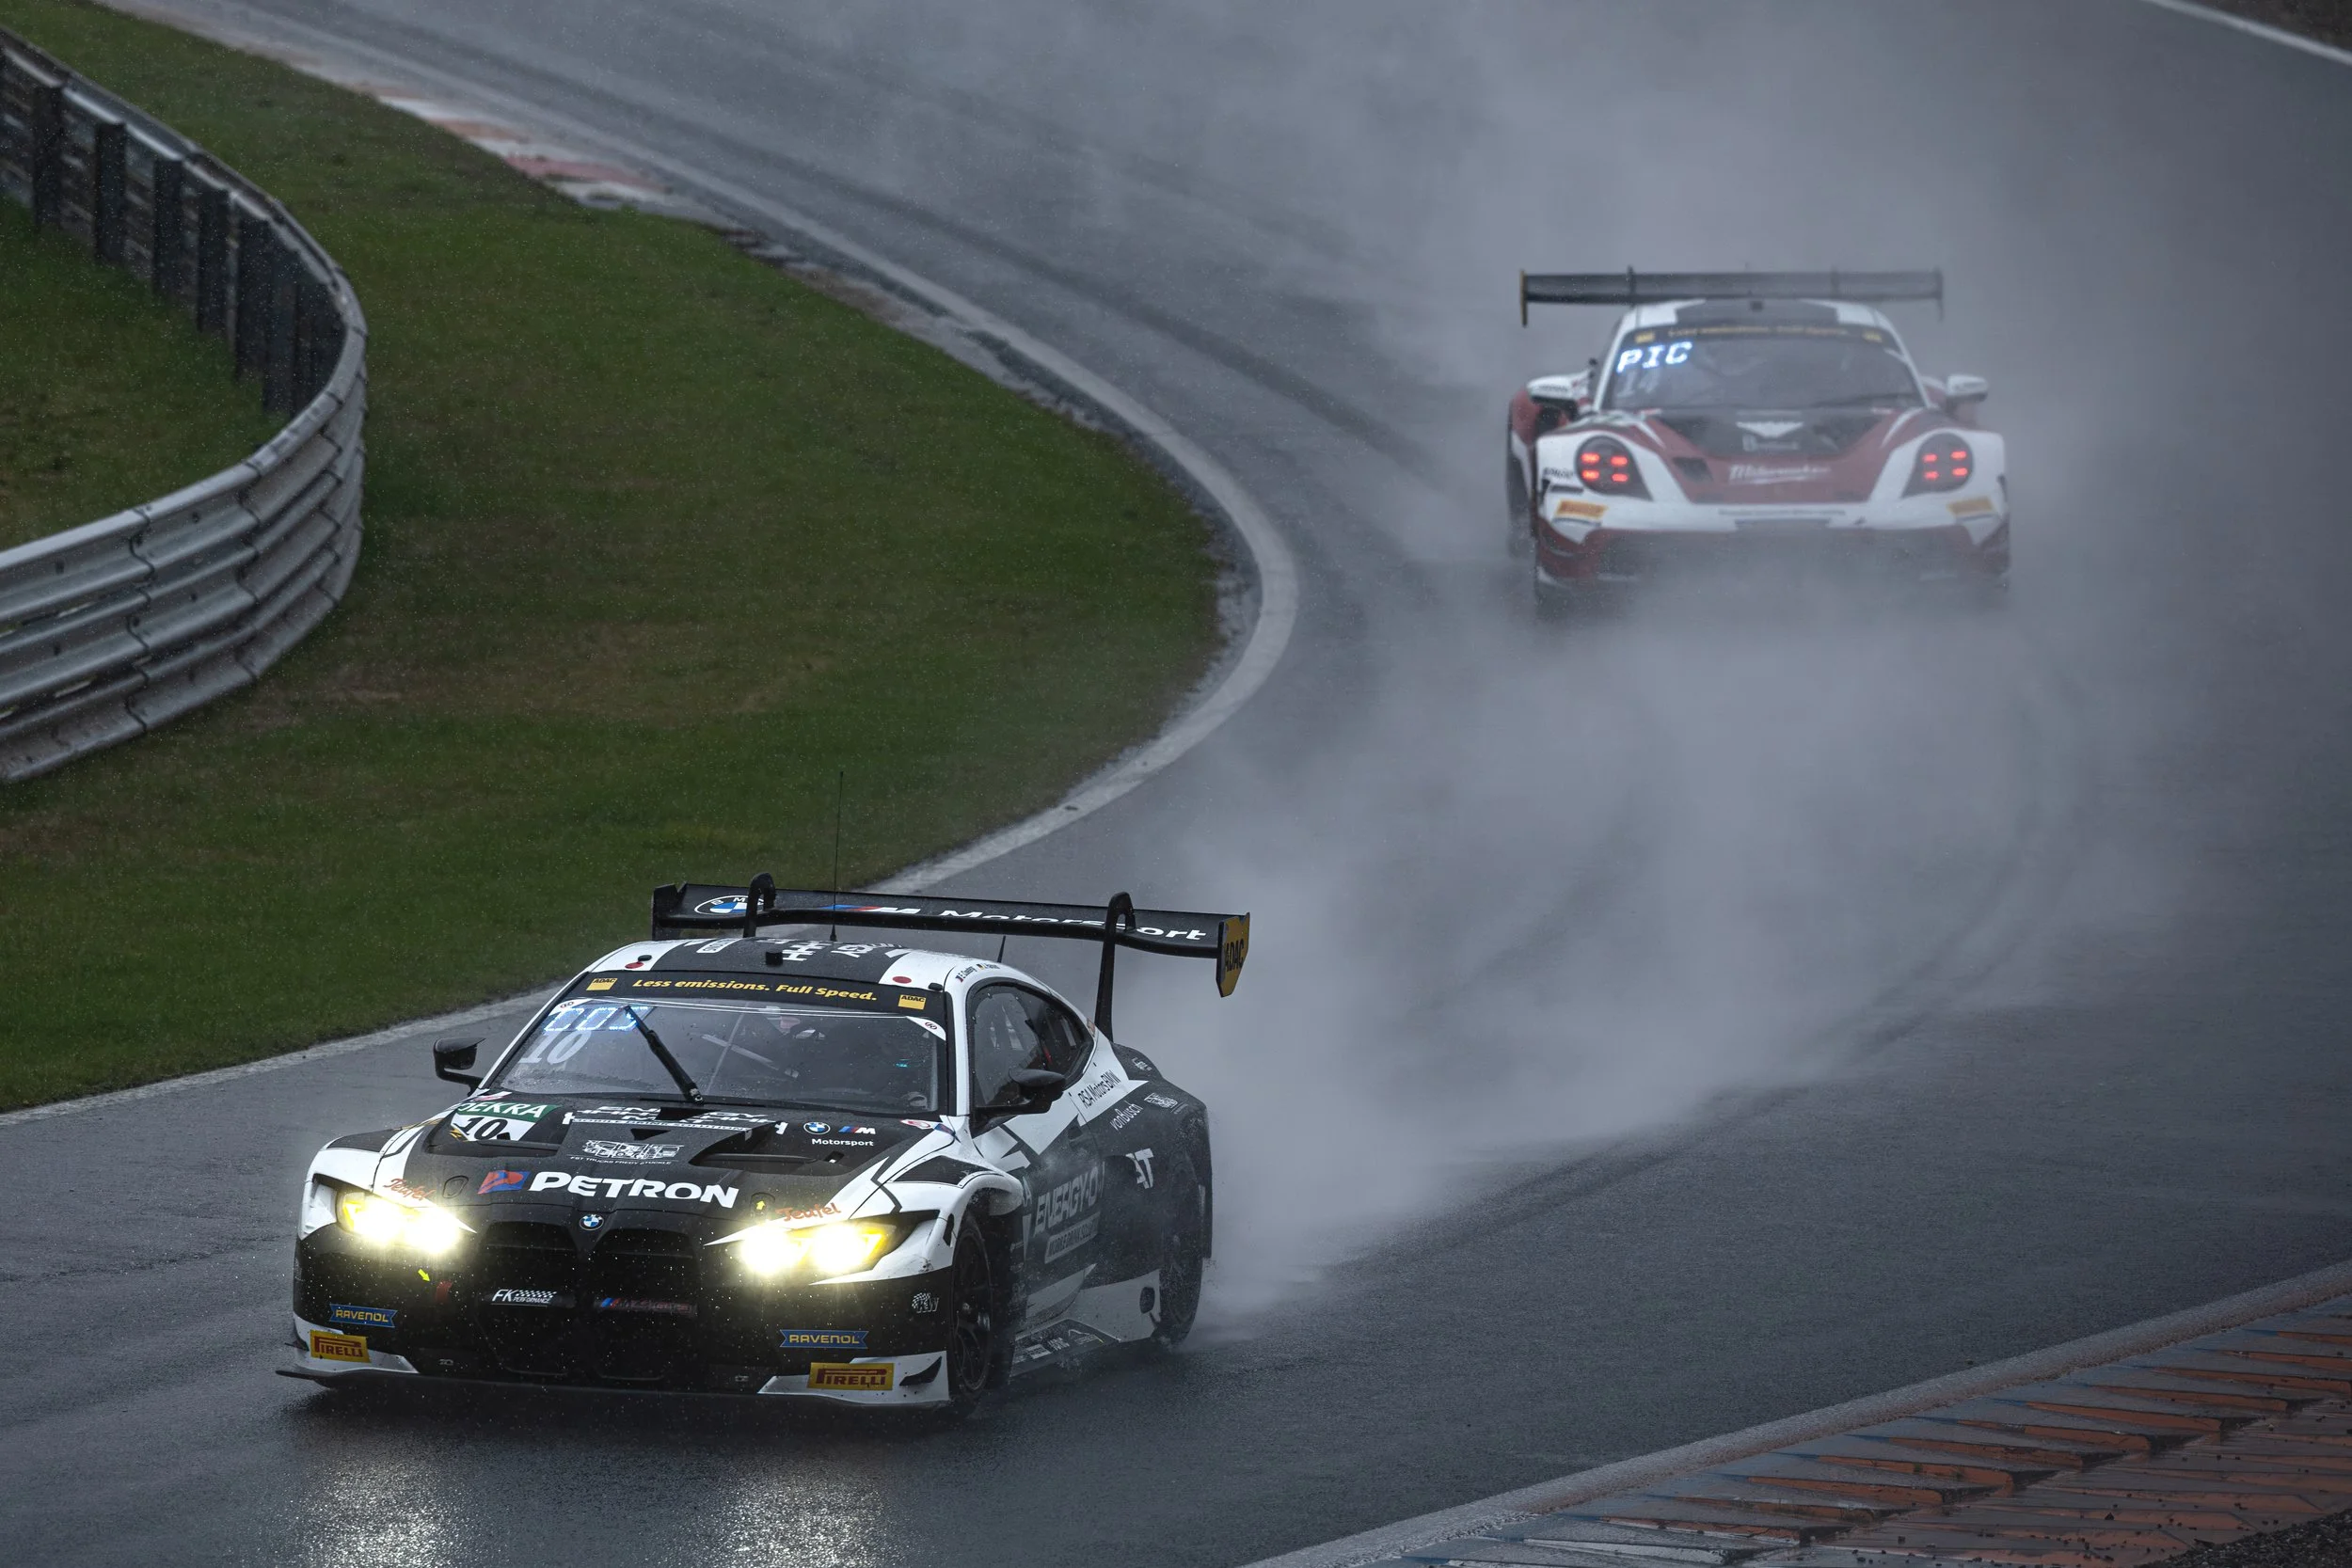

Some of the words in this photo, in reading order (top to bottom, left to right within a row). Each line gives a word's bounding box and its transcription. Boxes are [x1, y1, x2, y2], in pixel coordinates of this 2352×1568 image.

[1616, 341, 1692, 372] PIC
[940, 910, 1207, 941] Motorsort
[1224, 938, 1244, 972] ADAC
[632, 979, 671, 988] Less
[675, 980, 770, 991] emissions.
[775, 984, 812, 994] Full
[815, 988, 878, 1002] Speed.
[900, 994, 925, 1003] ADAC
[453, 1116, 508, 1141] 10
[812, 1138, 874, 1147] Motorsport
[529, 1171, 739, 1209] PETRON
[775, 1202, 842, 1222] Teufel
[492, 1289, 518, 1302] FK
[336, 1309, 389, 1323] RAVENOL
[314, 1336, 364, 1357] PIRELLI
[789, 1335, 859, 1344] RAVENOL
[816, 1368, 887, 1386] PIRELLI
